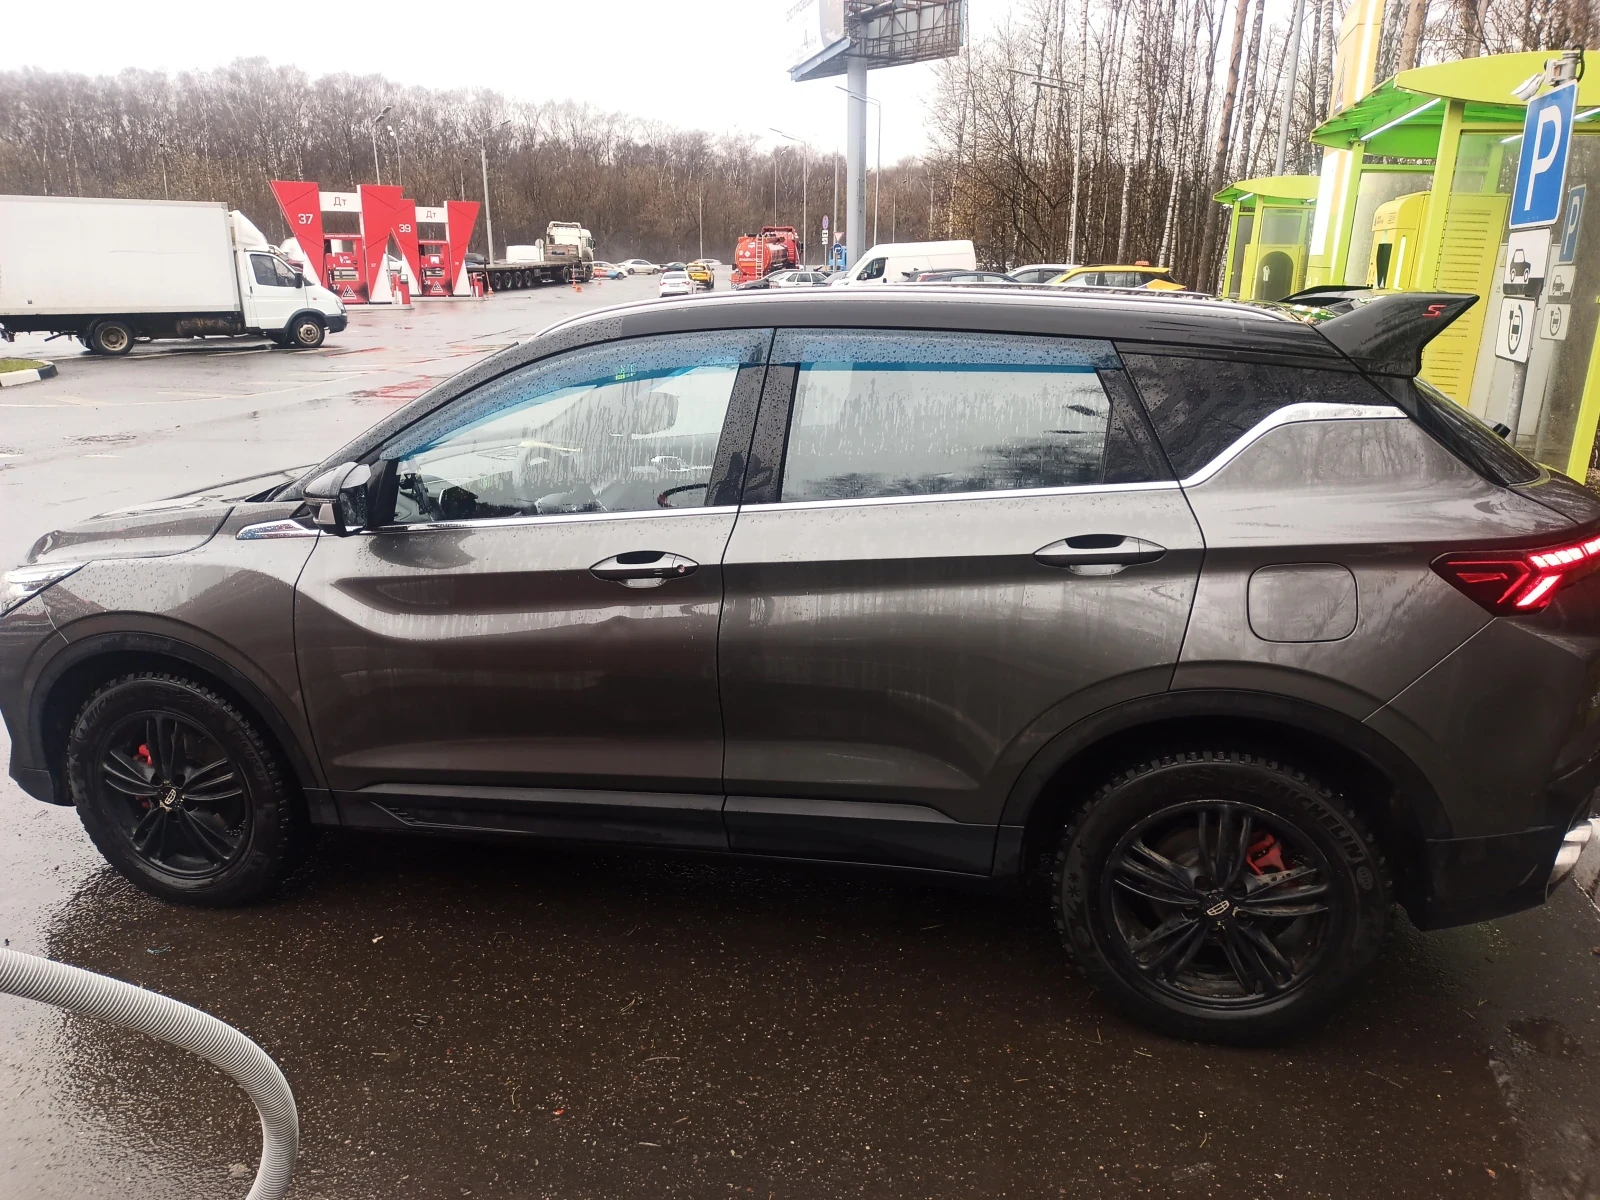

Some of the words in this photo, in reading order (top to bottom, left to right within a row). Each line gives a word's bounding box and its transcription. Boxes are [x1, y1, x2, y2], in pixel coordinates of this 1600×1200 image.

[1524, 104, 1562, 211] P
[298, 214, 313, 224] 37
[398, 224, 411, 233] 39
[1422, 304, 1447, 318] S
